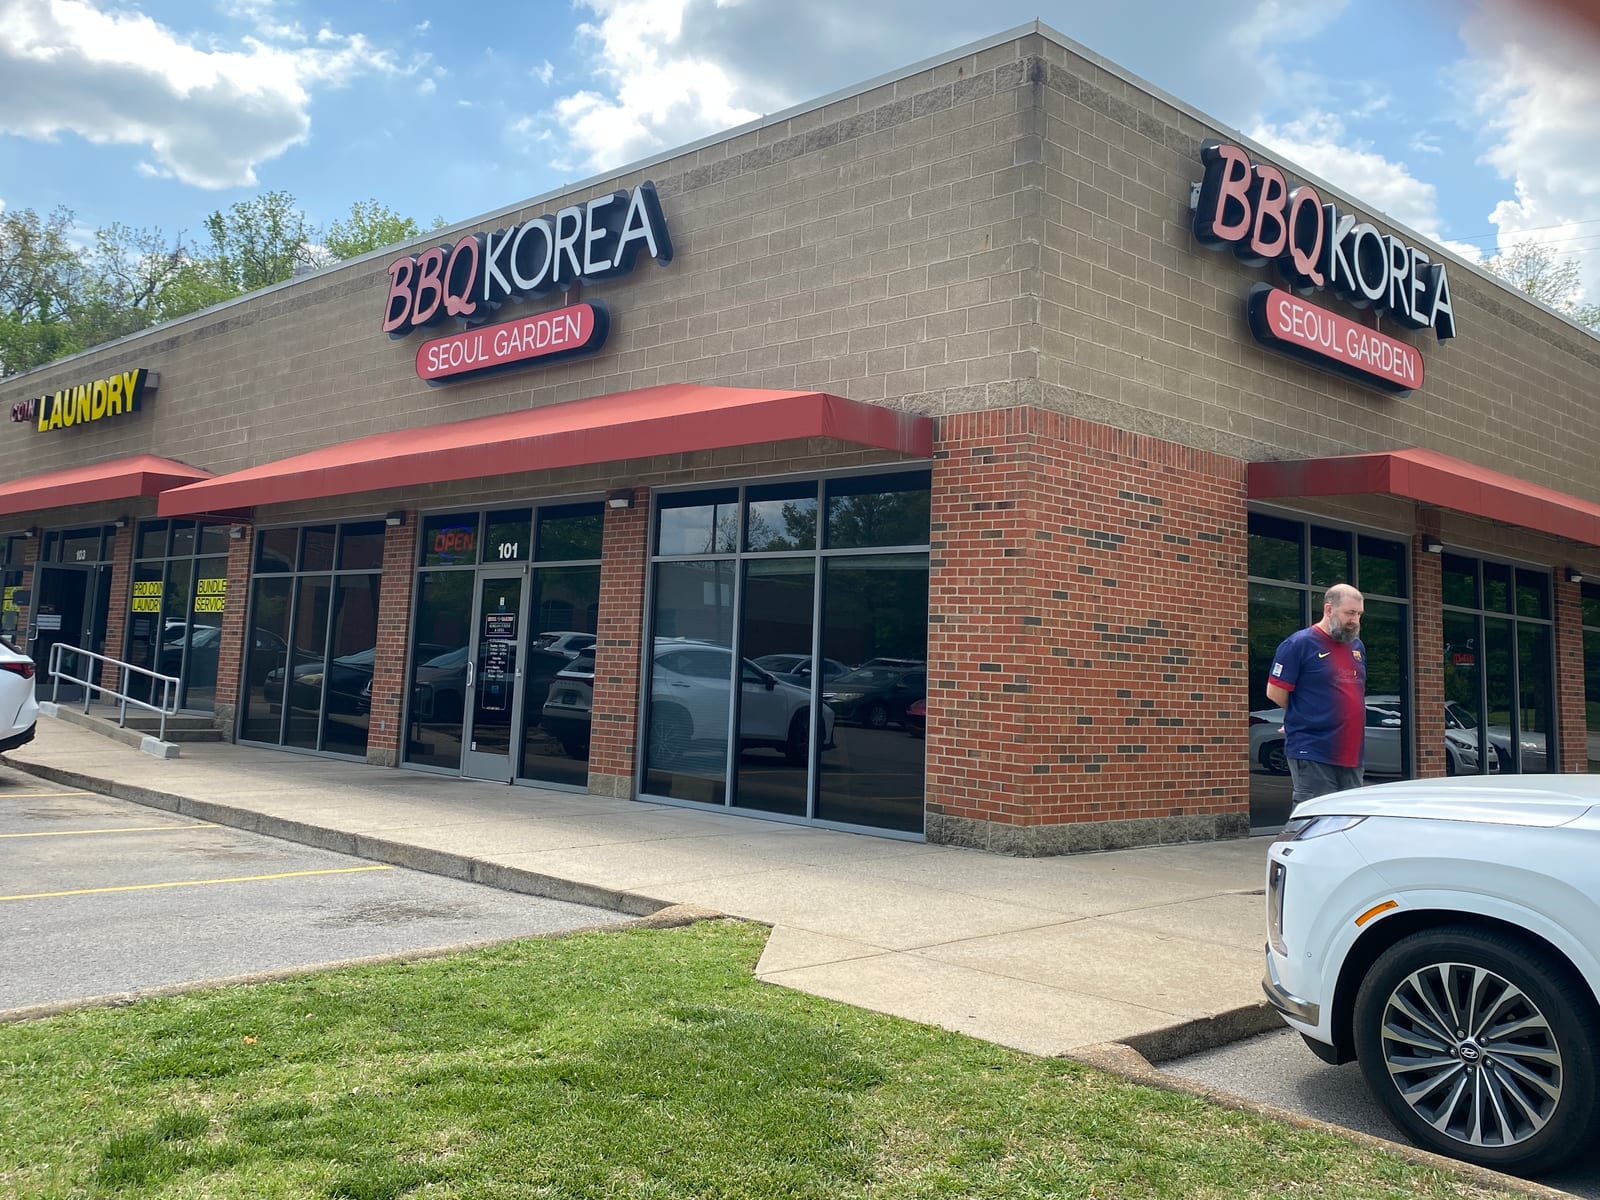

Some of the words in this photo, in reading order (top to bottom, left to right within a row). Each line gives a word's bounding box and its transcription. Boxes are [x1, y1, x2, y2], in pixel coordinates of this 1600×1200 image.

[382, 235, 480, 333] BBQ
[484, 185, 658, 301] KOREA
[1212, 144, 1325, 287] BBQ
[1329, 203, 1457, 338] KOREA
[427, 335, 489, 372] SEOUL
[494, 311, 582, 357] GARDEN
[1279, 300, 1343, 353] SEOUL
[1346, 328, 1415, 382] GARDEN
[10, 398, 36, 422] COIN
[37, 367, 140, 433] LAUNDRY
[434, 532, 474, 552] OPEN
[498, 542, 518, 559] 101
[134, 582, 147, 595] PRO
[198, 580, 227, 594] BUNDLE
